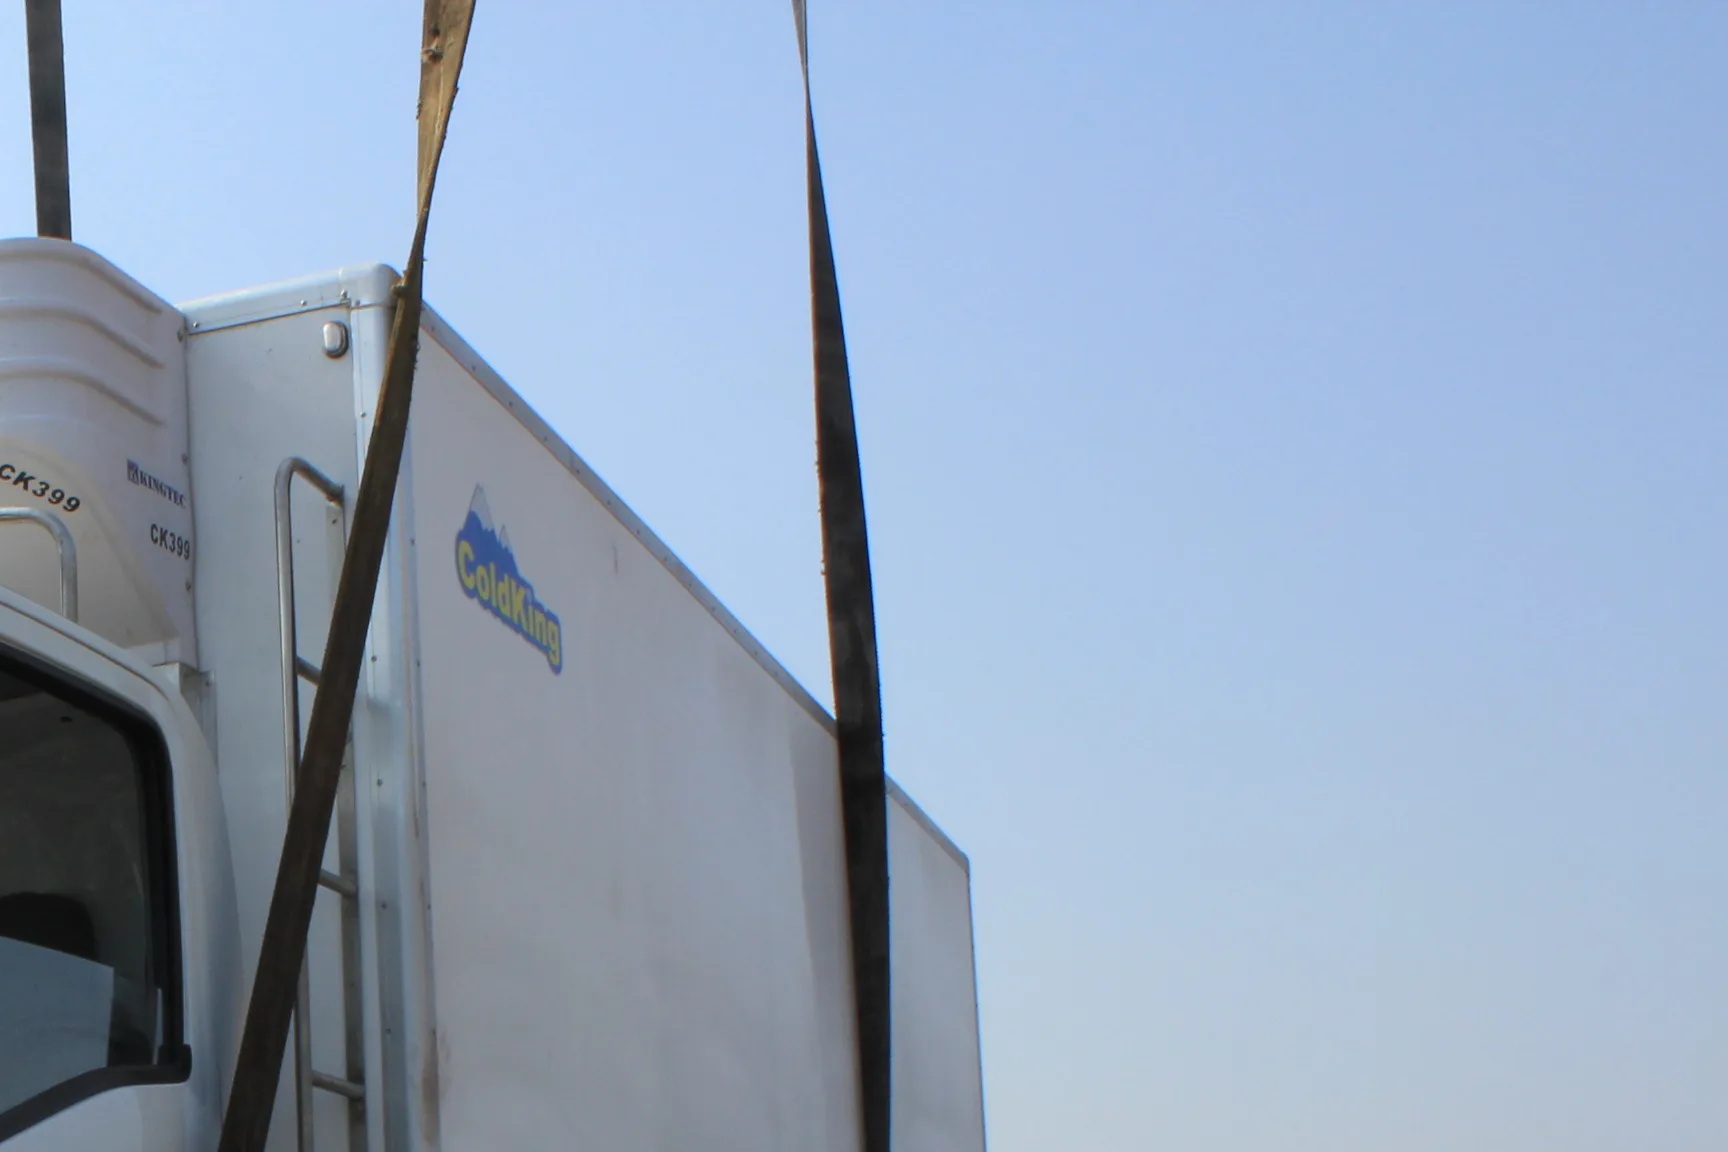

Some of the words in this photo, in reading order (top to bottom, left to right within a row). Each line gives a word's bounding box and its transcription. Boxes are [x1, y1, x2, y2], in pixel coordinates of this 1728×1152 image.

[139, 469, 186, 508] KINGTEC
[150, 523, 190, 560] CK399
[458, 540, 560, 667] ColdKing
